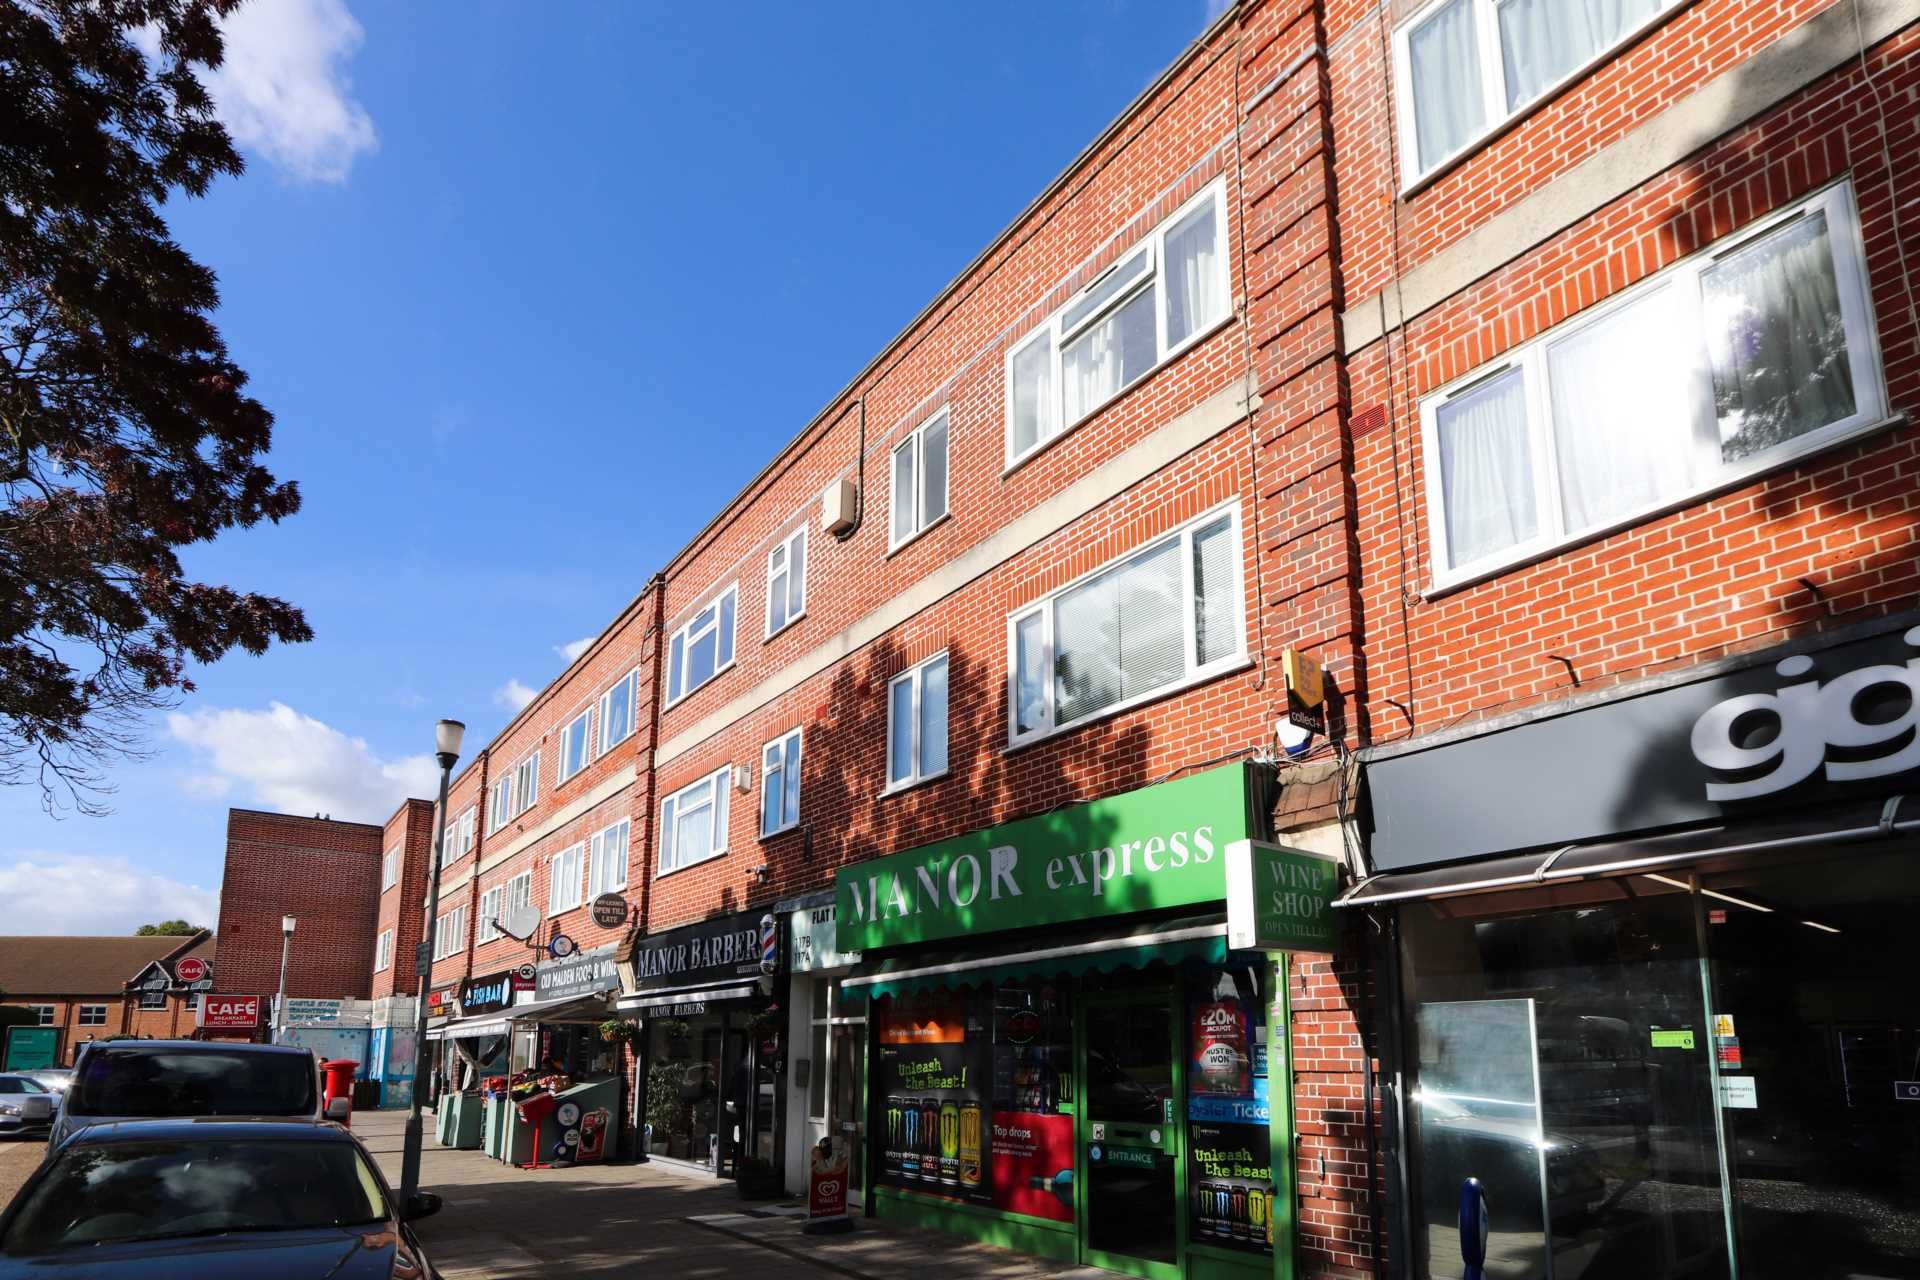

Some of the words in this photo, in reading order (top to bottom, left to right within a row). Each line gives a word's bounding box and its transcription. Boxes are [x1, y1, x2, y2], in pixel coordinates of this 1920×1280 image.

[847, 845, 1022, 927] MANOR
[1046, 824, 1216, 896] express
[1269, 861, 1322, 891] WINE
[593, 906, 610, 914] OPEN
[1273, 890, 1324, 919] SHOP
[812, 909, 829, 924] FLAT
[637, 944, 686, 978] MANOR
[541, 973, 551, 989] OLD
[552, 967, 575, 988] MALDEN
[486, 983, 501, 1003] BAR
[208, 1001, 256, 1015] CAFÉ
[649, 1006, 671, 1018] MANOR
[674, 1002, 705, 1015] BARBERS
[1201, 1008, 1236, 1026] £20M
[898, 1057, 942, 1076] Unleash
[1210, 1055, 1230, 1063] WON
[905, 1075, 925, 1089] the
[1232, 1103, 1269, 1119] Ticke
[993, 1125, 1008, 1138] Top
[1009, 1126, 1031, 1140] drops
[1107, 1150, 1153, 1163] ENTRANCE
[1194, 1147, 1253, 1162] Unleash
[1205, 1162, 1231, 1177] the
